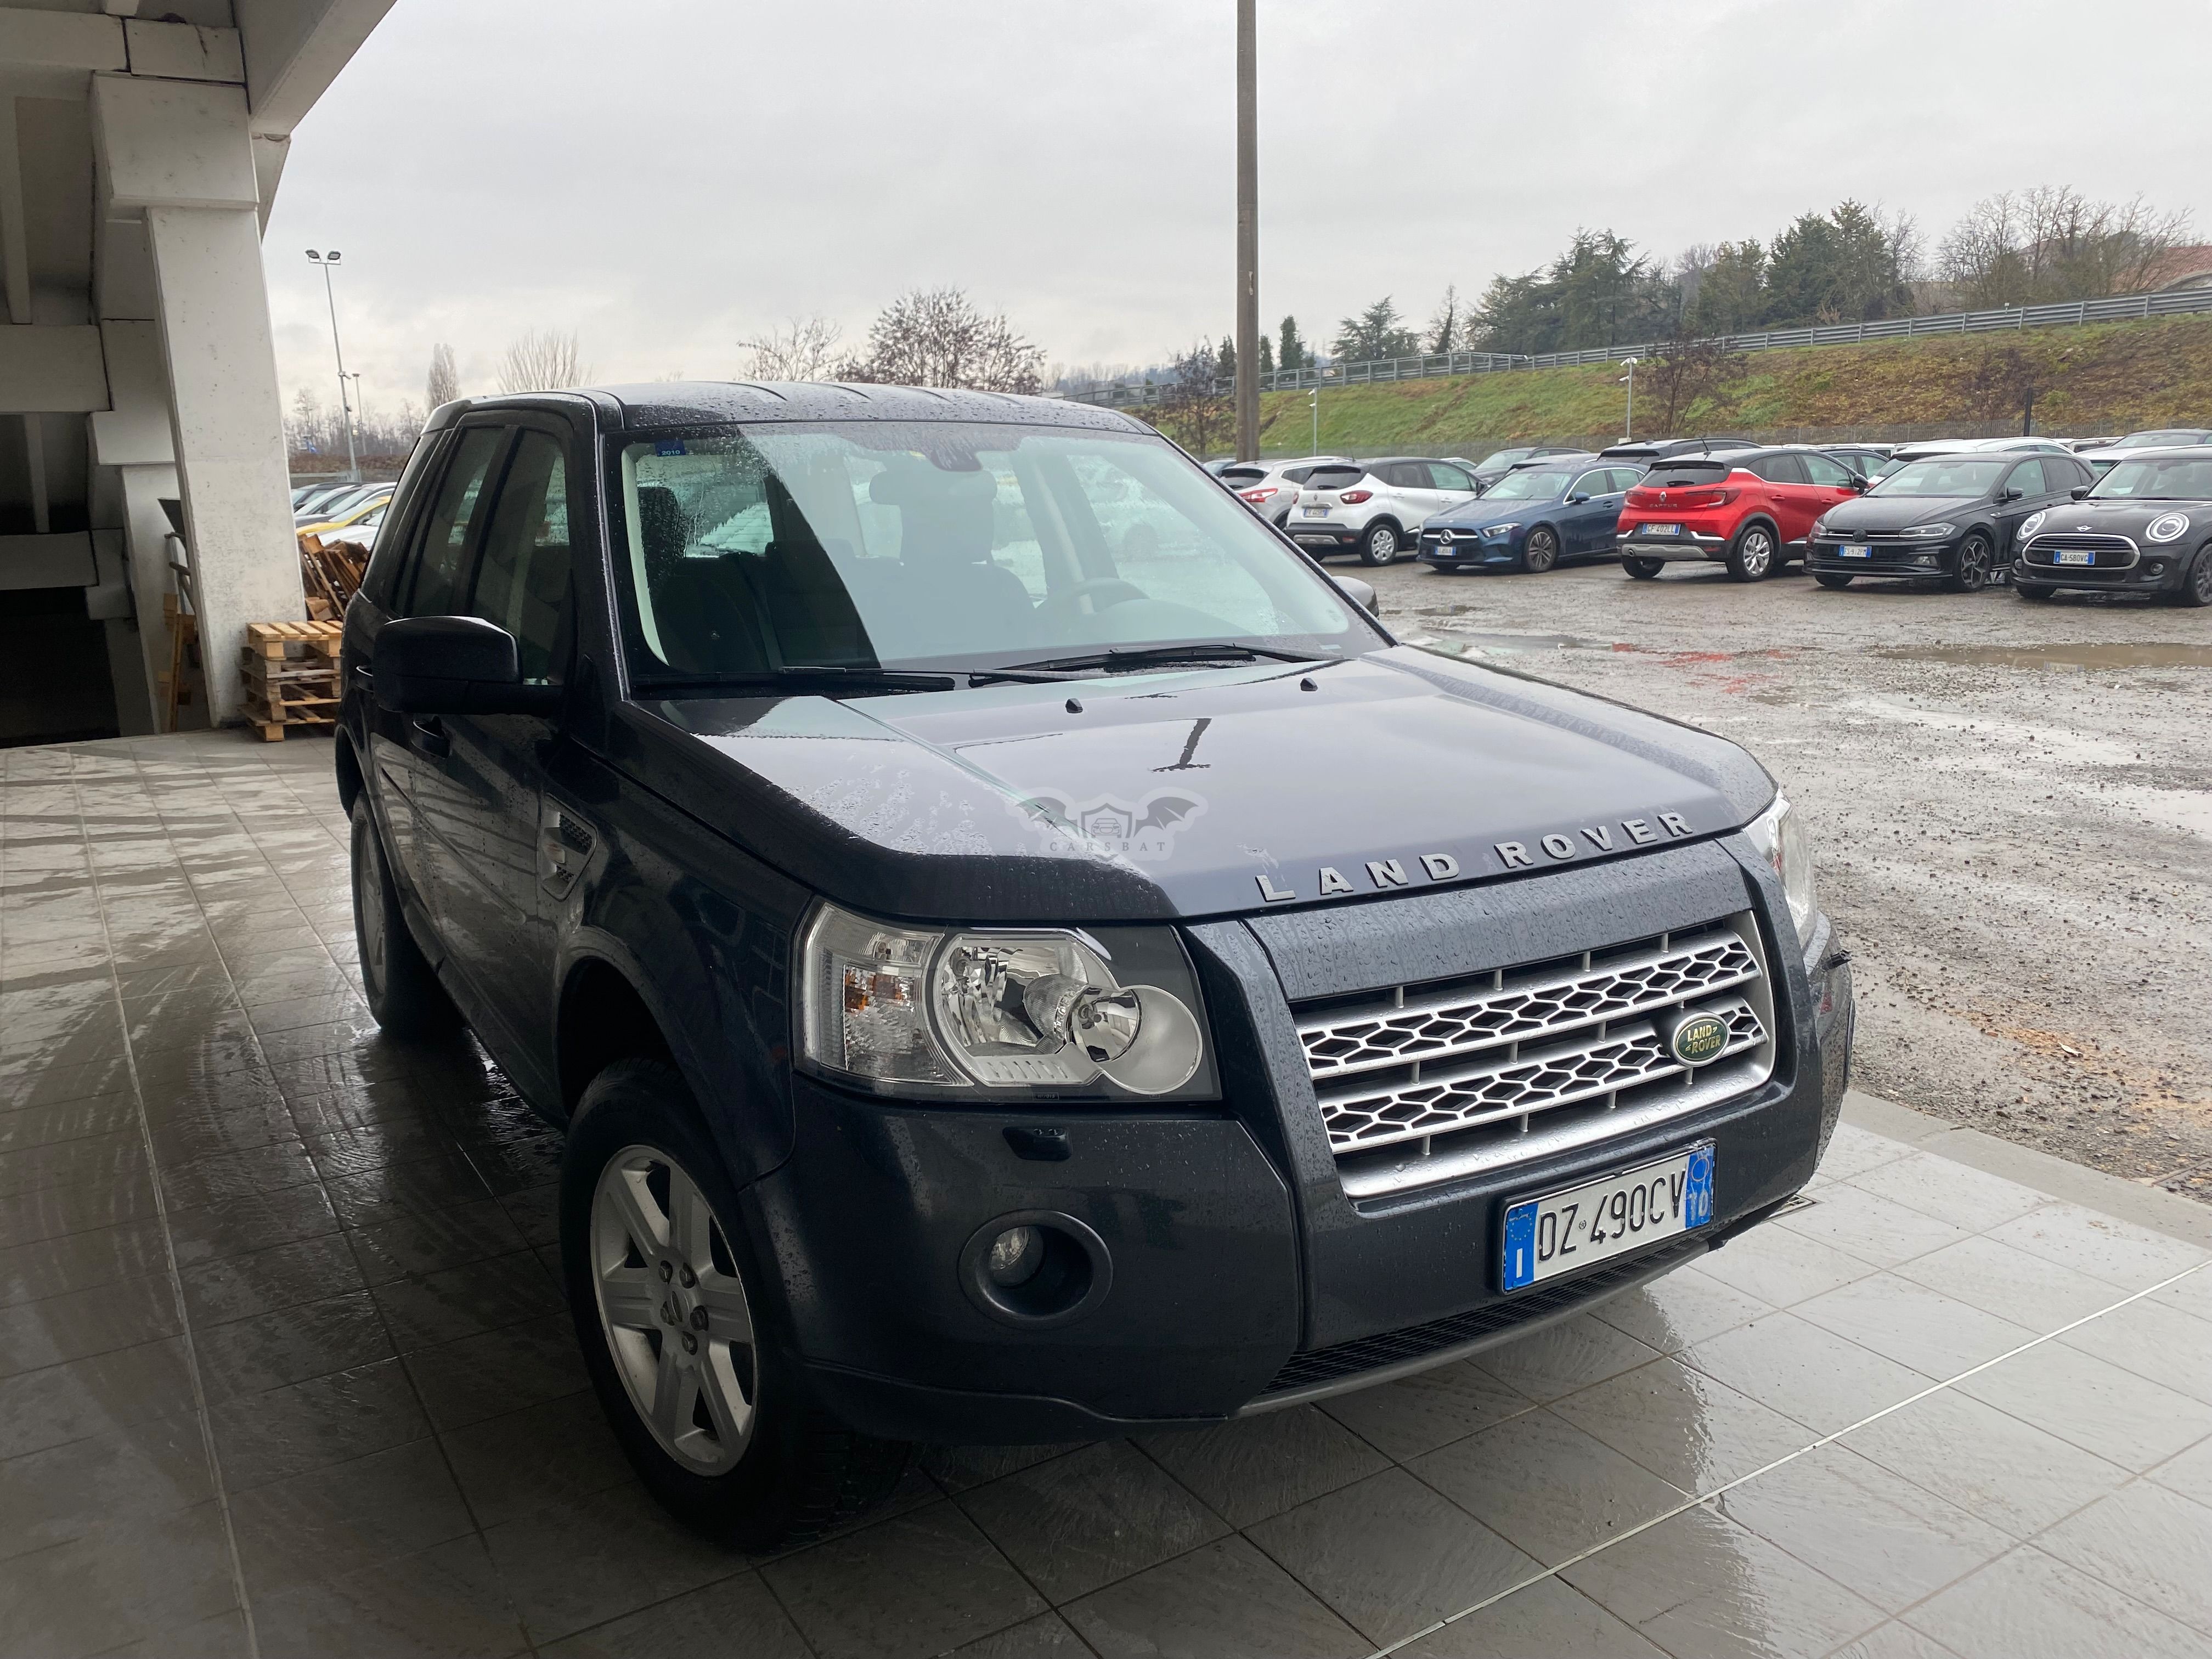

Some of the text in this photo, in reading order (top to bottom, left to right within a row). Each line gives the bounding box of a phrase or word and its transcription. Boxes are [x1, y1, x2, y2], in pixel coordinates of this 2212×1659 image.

[1255, 811, 1695, 902] LAND ROVER
[1687, 1024, 1712, 1042] LAND
[1691, 1035, 1721, 1054] ROVER
